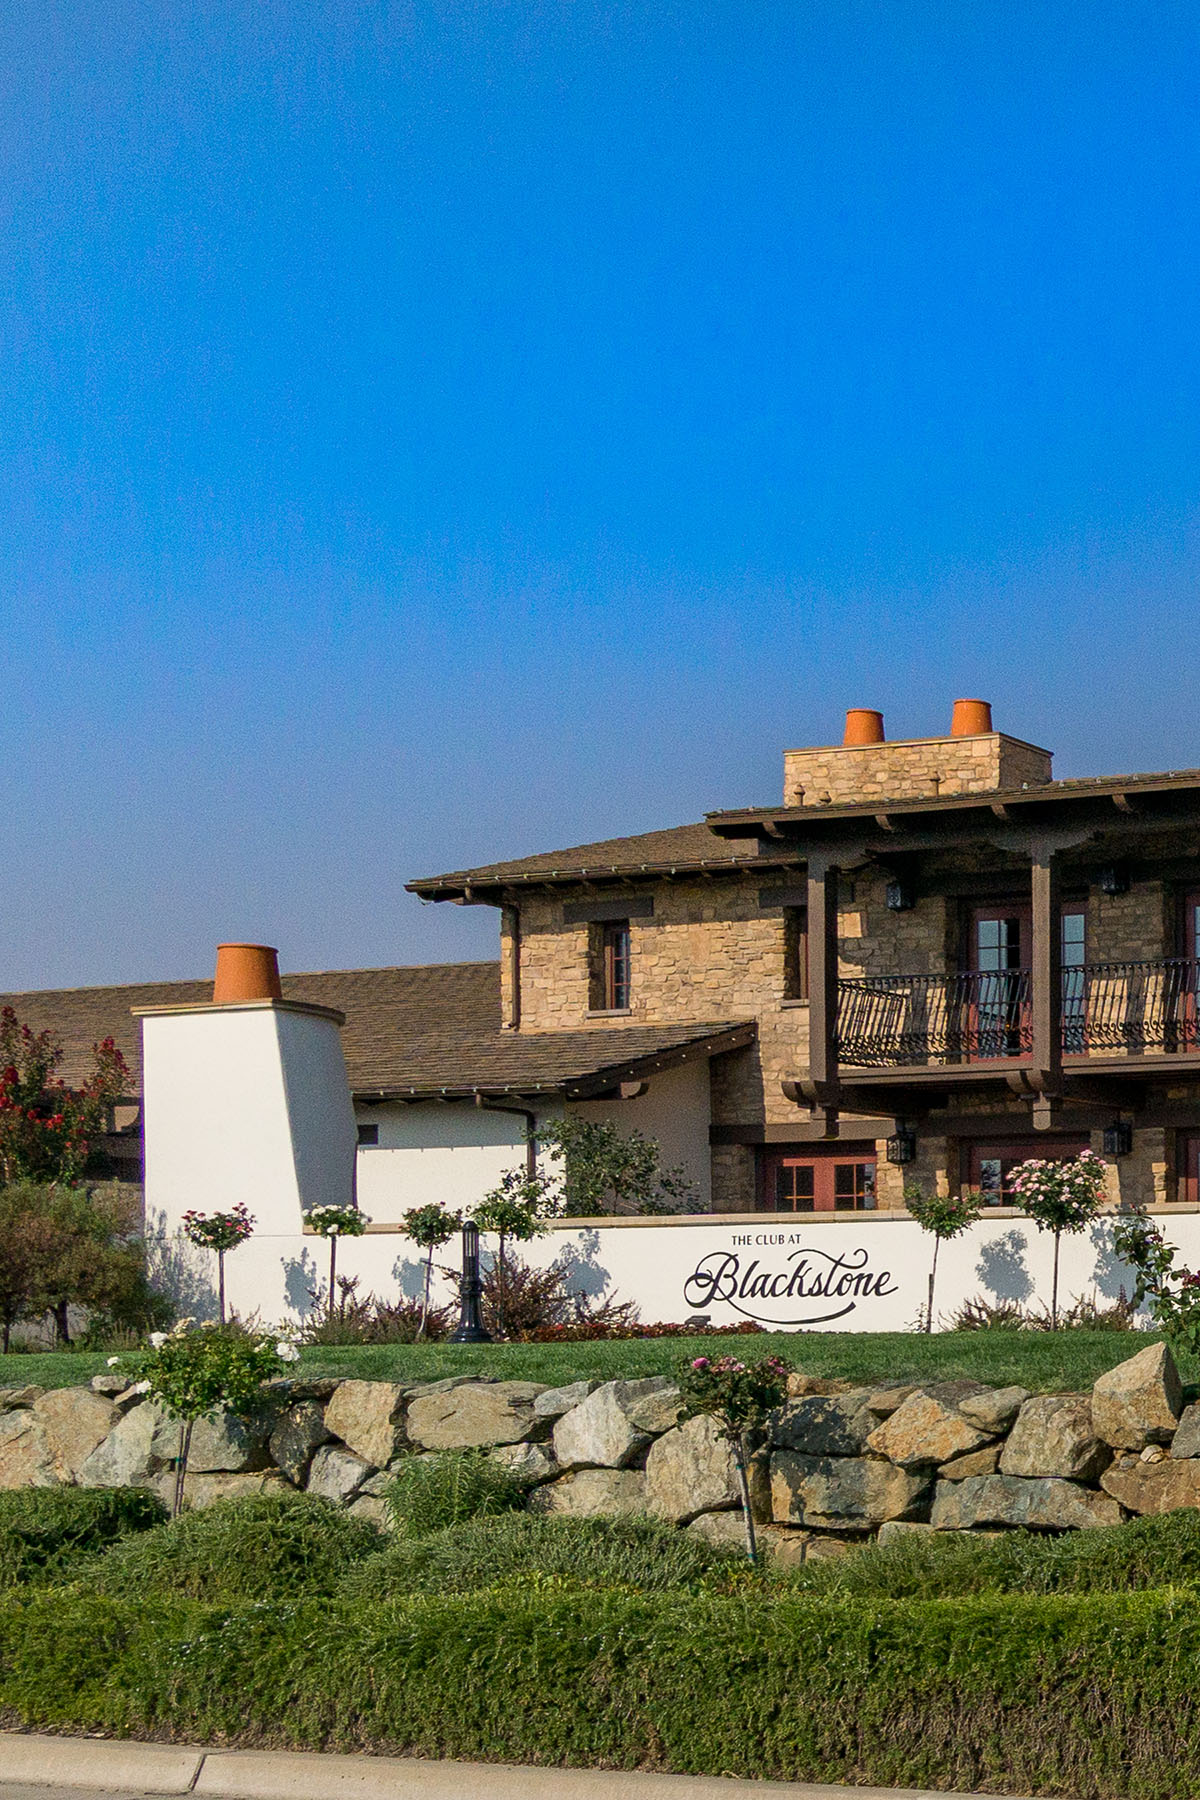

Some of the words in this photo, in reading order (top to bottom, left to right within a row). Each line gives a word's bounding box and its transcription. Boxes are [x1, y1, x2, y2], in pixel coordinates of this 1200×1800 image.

[732, 1235, 752, 1246] THE
[755, 1234, 785, 1245] CLUB
[787, 1234, 802, 1245] AT
[683, 1248, 899, 1325] Blackstone
